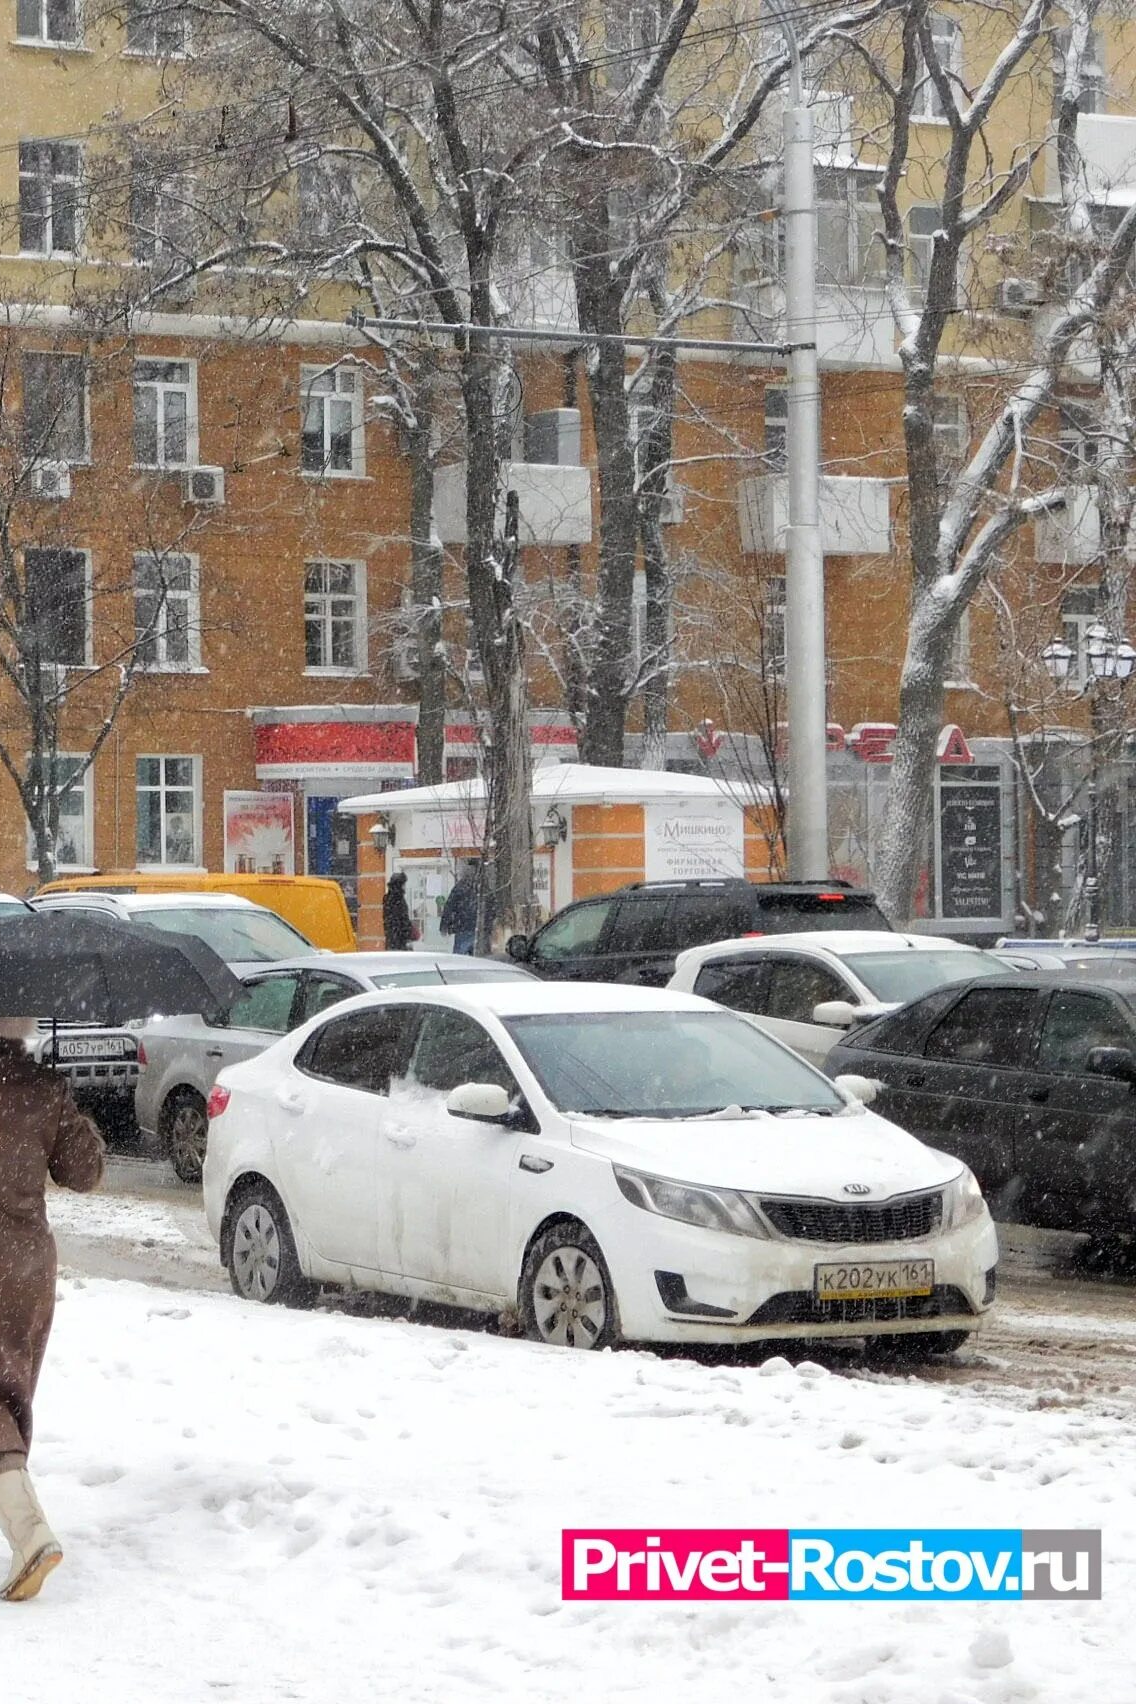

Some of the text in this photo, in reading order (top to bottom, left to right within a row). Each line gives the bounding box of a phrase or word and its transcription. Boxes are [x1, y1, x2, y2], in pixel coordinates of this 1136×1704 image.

[846, 1183, 869, 1194] KIA
[822, 1263, 929, 1290] К202УК 161
